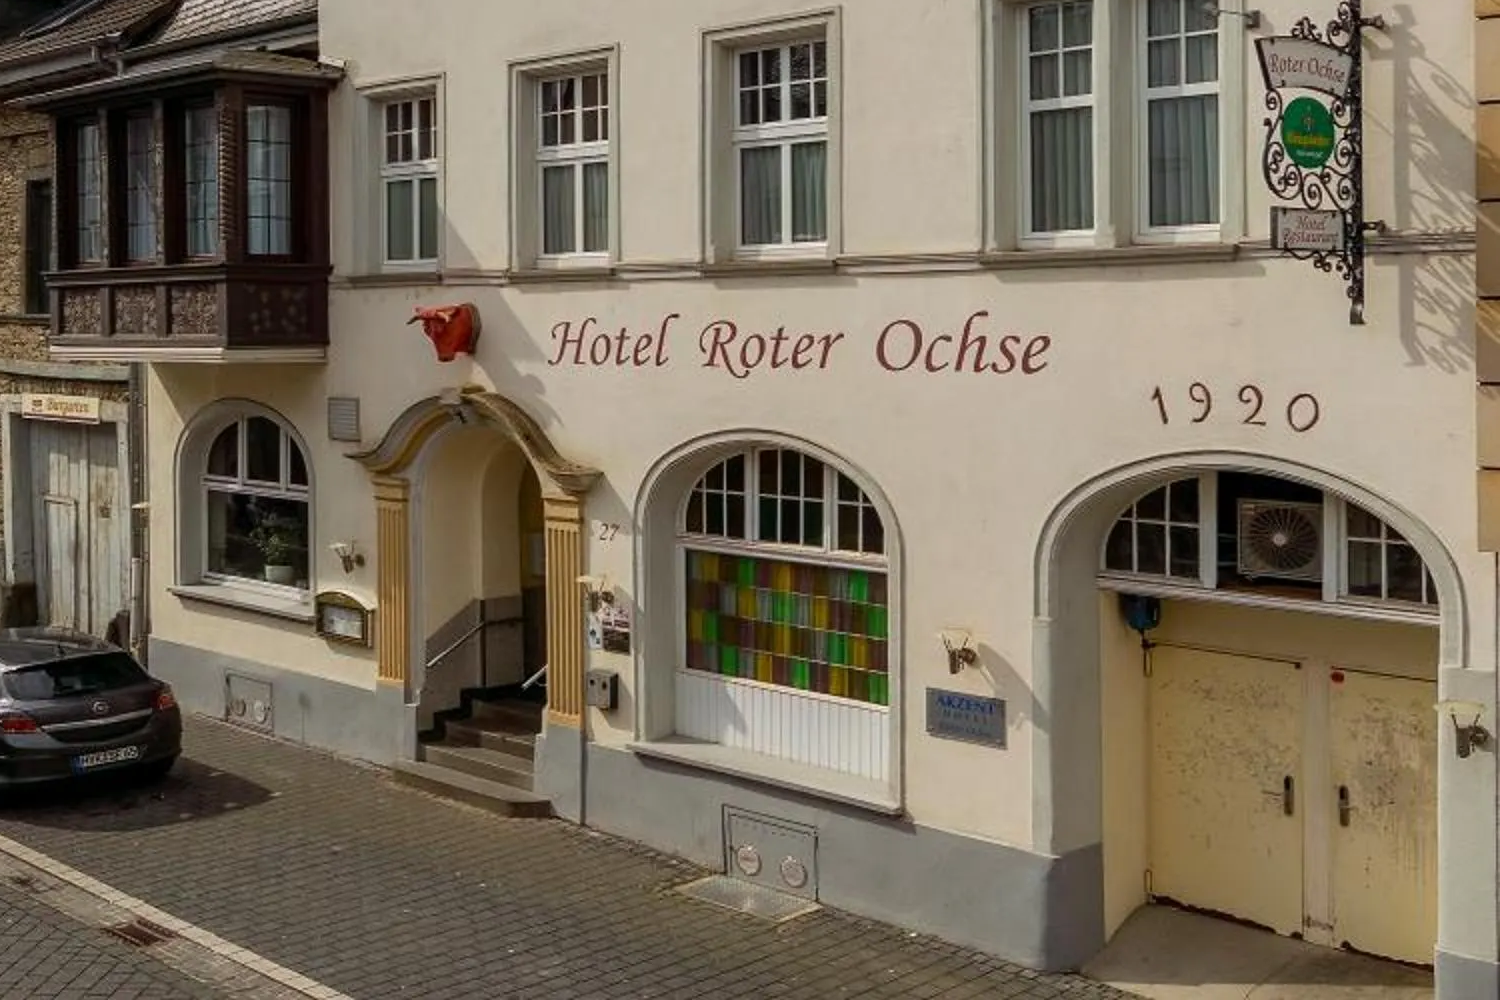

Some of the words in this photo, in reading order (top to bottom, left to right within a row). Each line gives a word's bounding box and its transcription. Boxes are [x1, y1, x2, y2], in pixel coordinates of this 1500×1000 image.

[1268, 52, 1304, 75] Roter
[1307, 56, 1346, 83] Ochse
[547, 313, 681, 368] Hotel
[699, 319, 845, 379] Roter
[875, 309, 1052, 376] Ochse
[1151, 381, 1320, 433] 1920
[599, 522, 620, 541] 27
[937, 695, 997, 715] AKZENT
